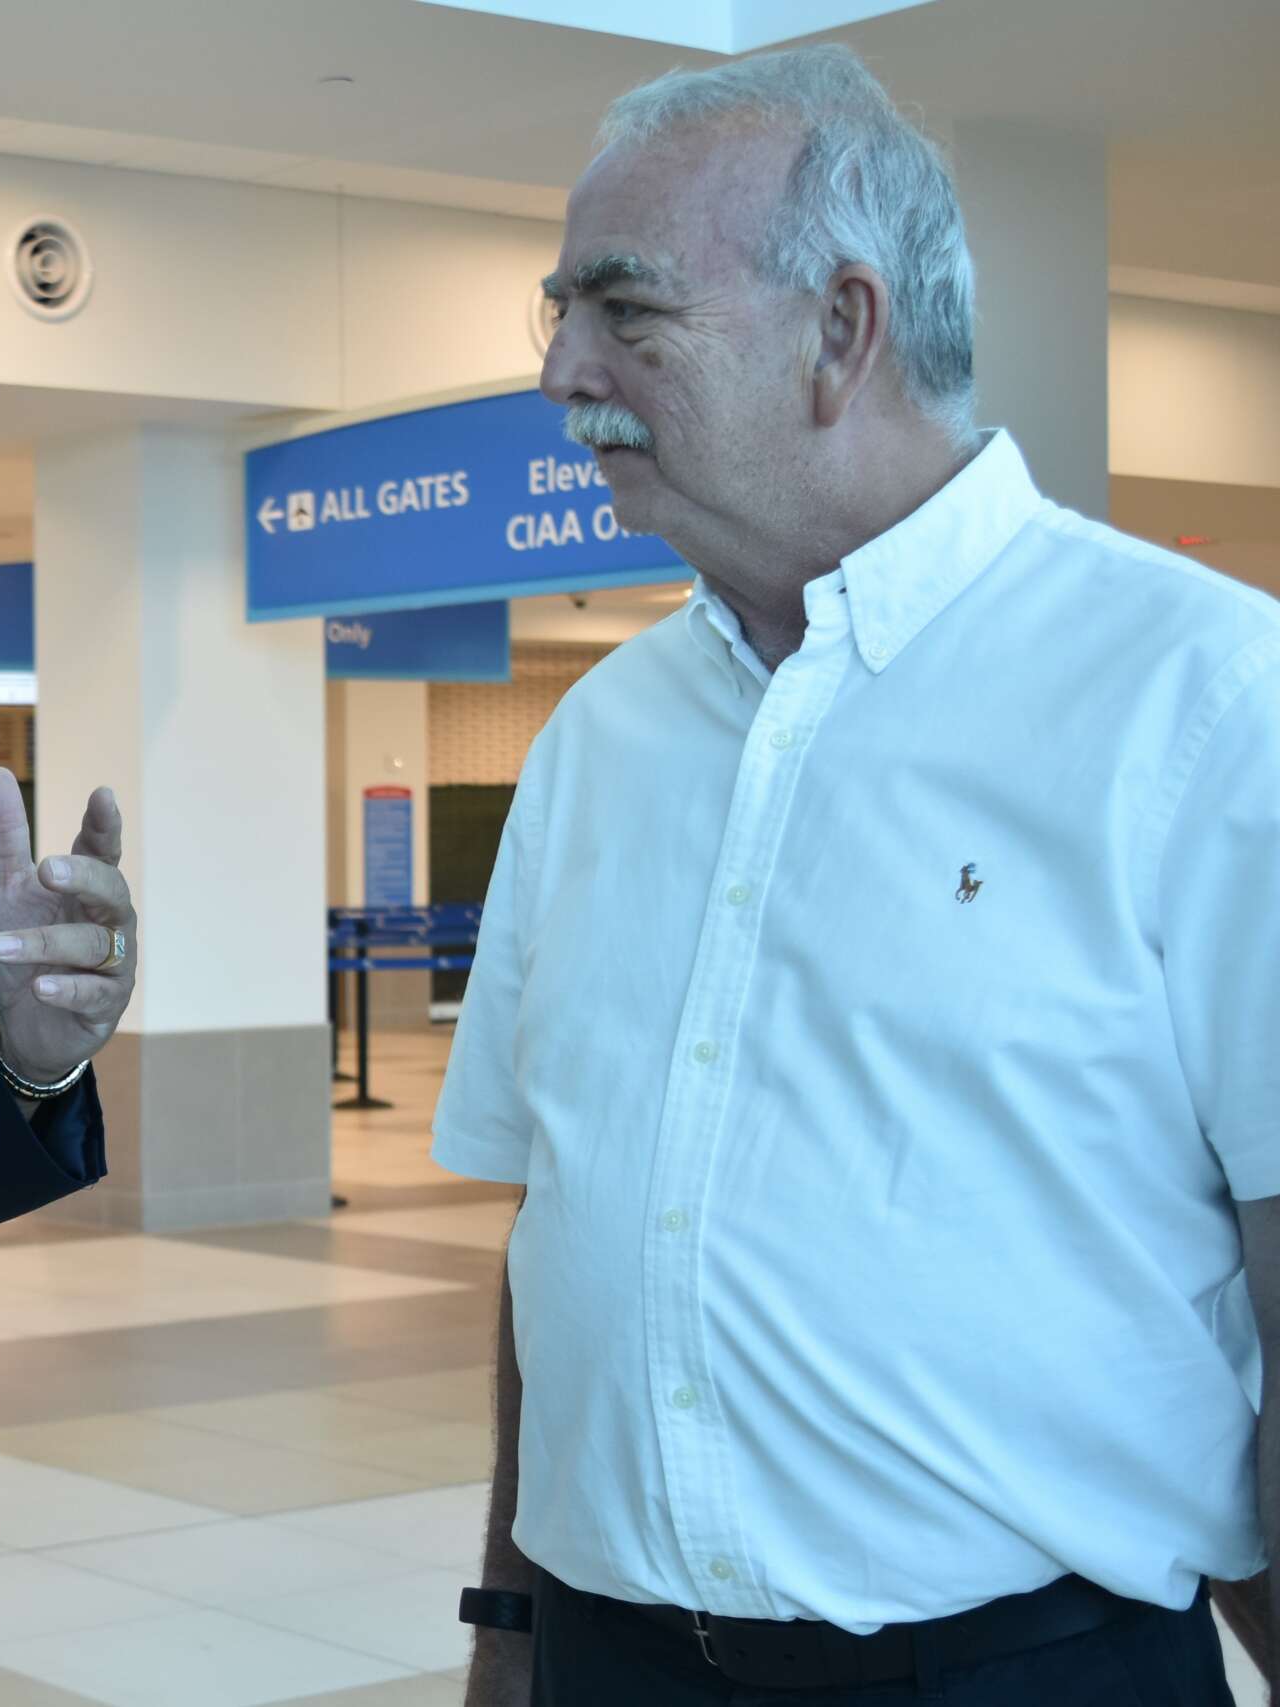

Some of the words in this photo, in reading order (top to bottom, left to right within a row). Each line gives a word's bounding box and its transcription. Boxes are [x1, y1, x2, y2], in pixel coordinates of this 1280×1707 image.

[321, 485, 372, 524] ALL
[377, 470, 470, 516] GATES
[505, 508, 585, 552] CIAA
[327, 621, 371, 650] Only
